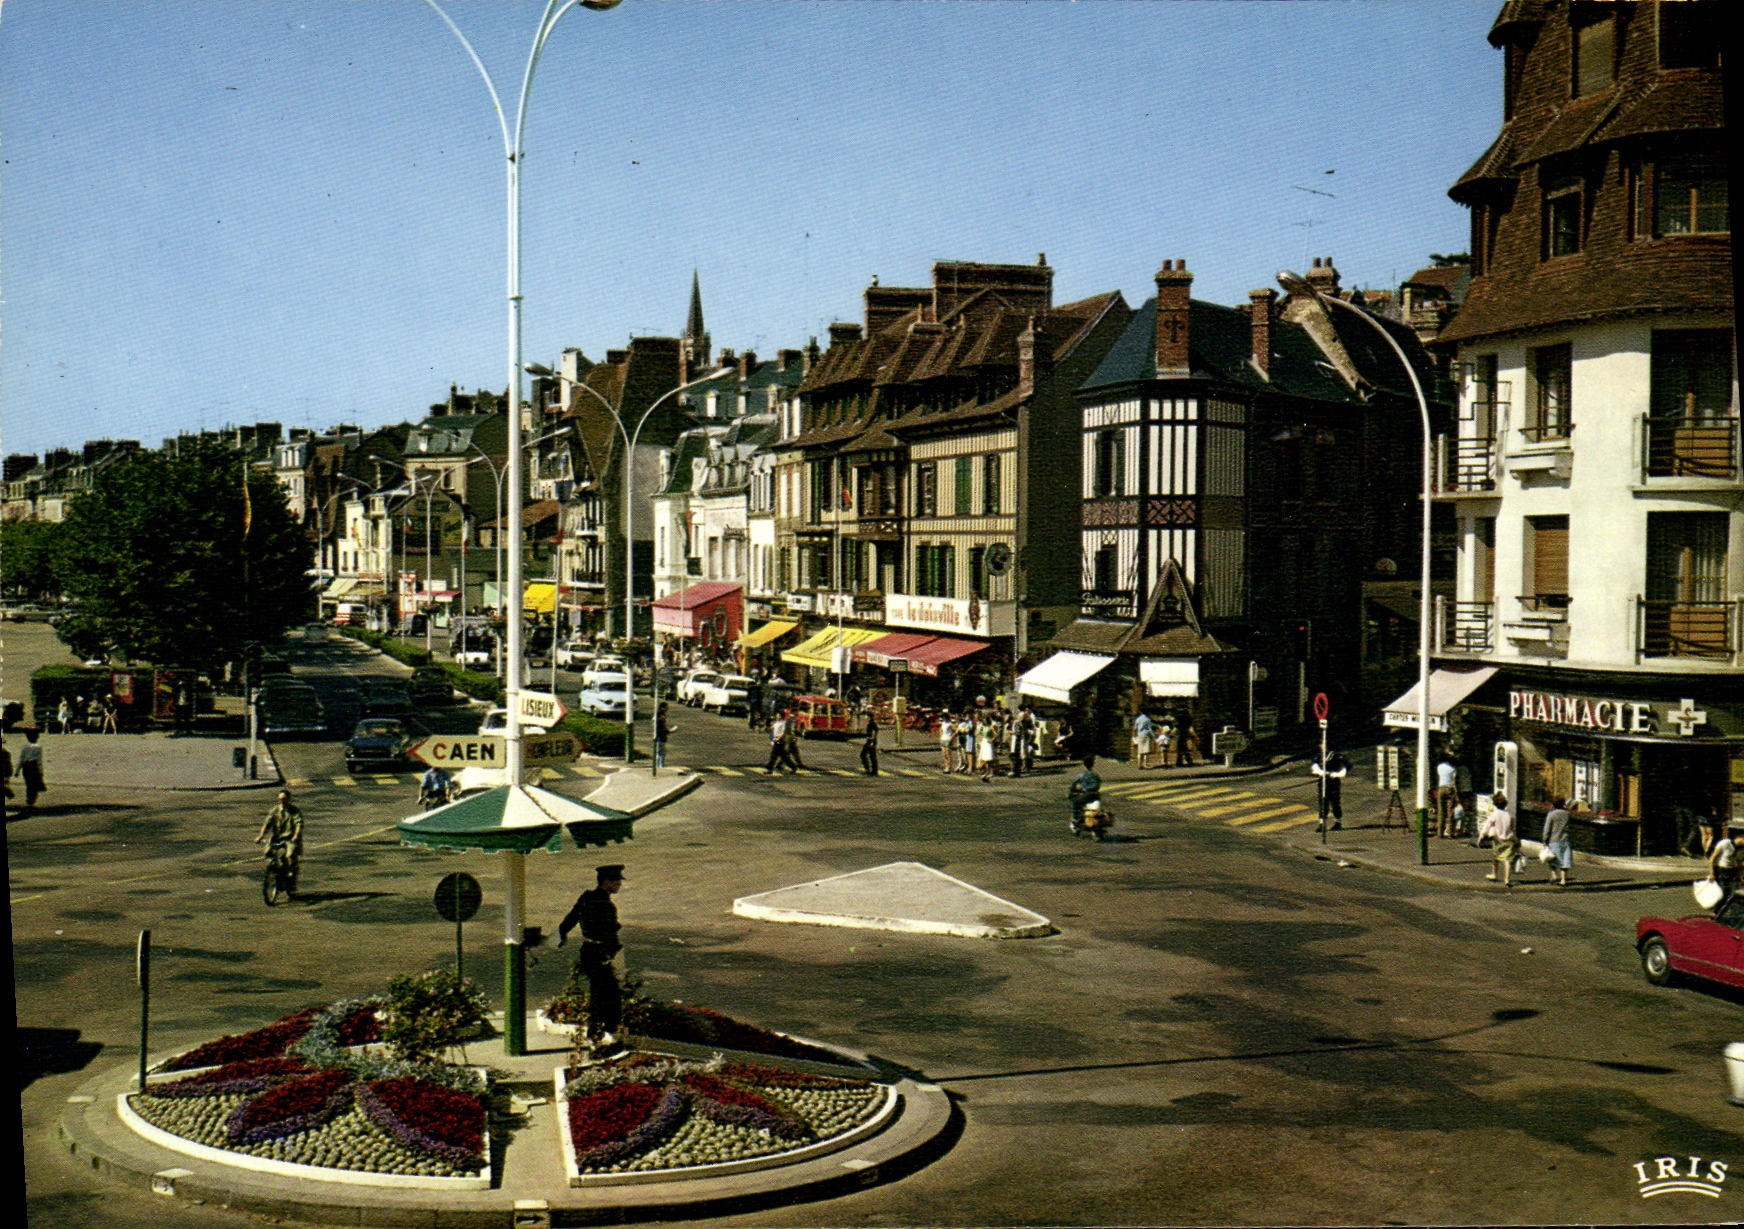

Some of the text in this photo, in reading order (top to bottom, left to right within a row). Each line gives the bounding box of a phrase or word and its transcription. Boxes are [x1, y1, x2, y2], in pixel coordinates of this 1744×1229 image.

[521, 698, 555, 720] LISIEUX
[1508, 690, 1652, 733] PHARMACIE
[432, 743, 496, 761] CAEN
